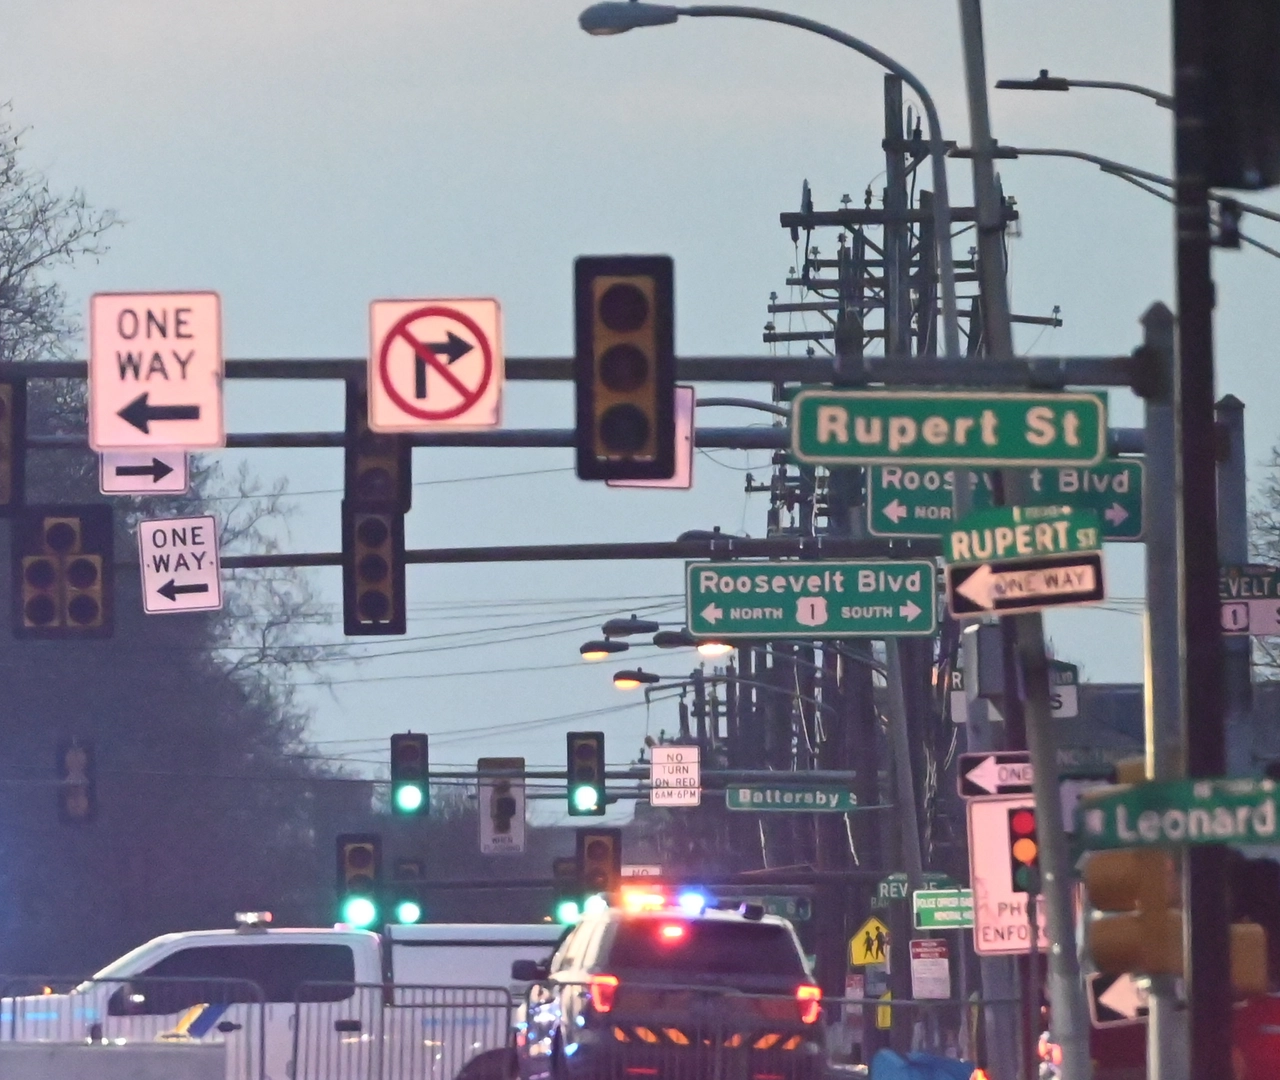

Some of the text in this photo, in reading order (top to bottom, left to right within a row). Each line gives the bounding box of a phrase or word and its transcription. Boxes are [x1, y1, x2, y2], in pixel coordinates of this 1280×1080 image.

[117, 308, 194, 340] ONE
[116, 350, 195, 381] WAY
[816, 405, 1080, 452] Rupert St
[1058, 468, 1130, 493] Blvd
[914, 506, 952, 519] NOR
[152, 526, 205, 549] ONE
[950, 521, 1098, 560] RUPERT ST
[152, 551, 206, 574] WAY
[699, 569, 921, 594] Roosevelt Blvd
[995, 570, 1085, 594] ONE WAY
[1219, 577, 1271, 597] EVELT
[730, 607, 783, 620] NORTH
[809, 603, 815, 621] 1
[841, 605, 893, 619] SOUTH
[1231, 608, 1238, 626] 1
[666, 752, 683, 763] NO
[662, 765, 689, 775] TURN
[655, 777, 669, 787] ON
[675, 777, 696, 787] RED
[1115, 797, 1276, 842] Leonard
[982, 925, 1028, 942] ENFO
